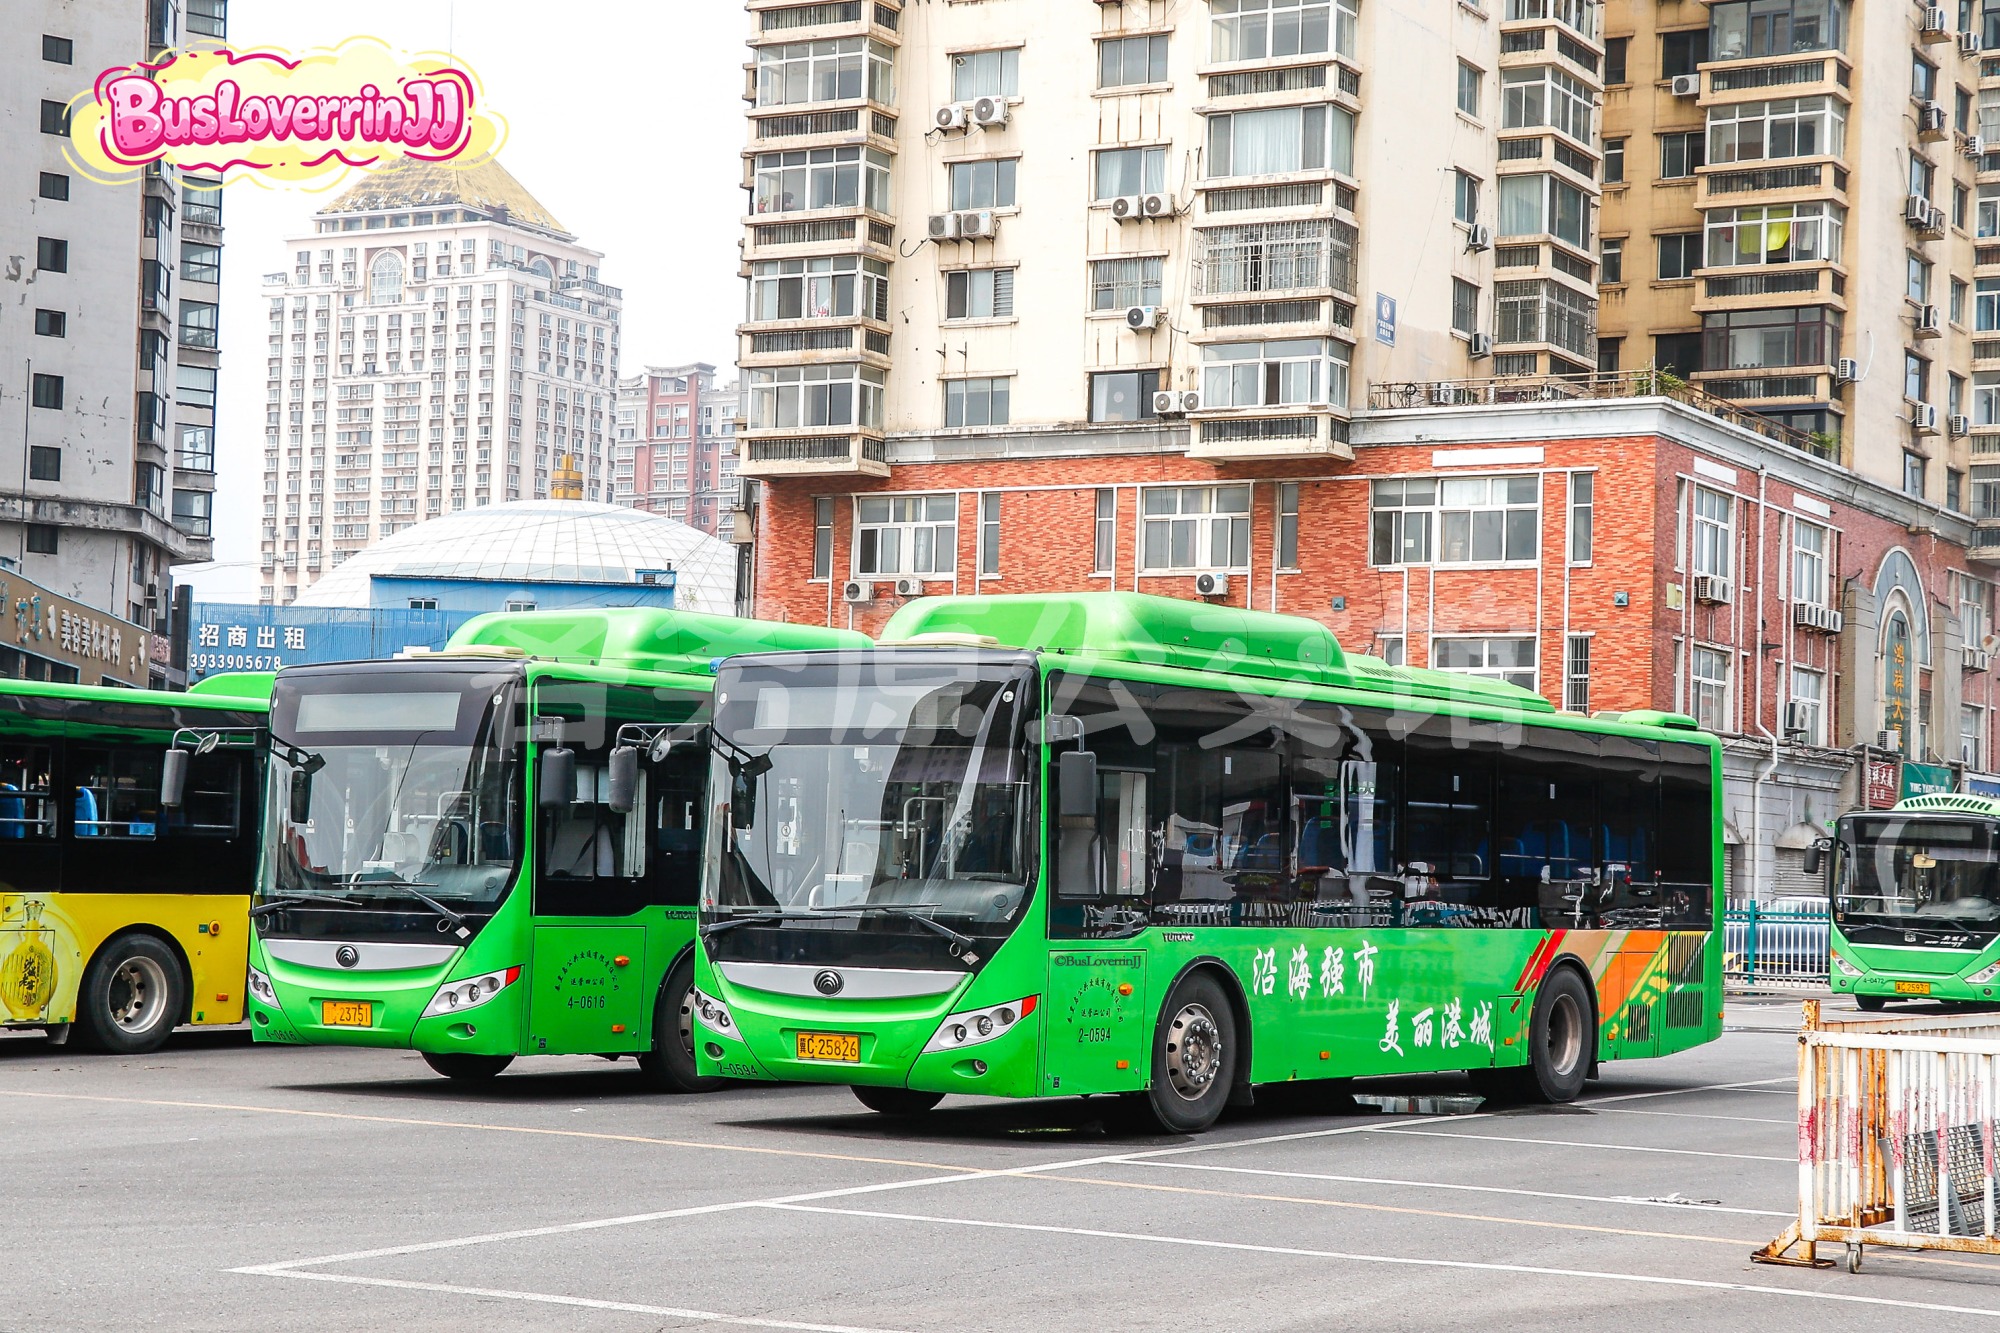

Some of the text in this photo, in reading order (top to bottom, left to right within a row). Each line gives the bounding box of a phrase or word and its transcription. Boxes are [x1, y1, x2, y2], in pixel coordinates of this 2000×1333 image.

[60, 609, 121, 666] 美容美体机构
[198, 623, 306, 650] 招商出租
[190, 653, 281, 670] 3933905678
[1162, 932, 1195, 942] YUTONG
[1253, 939, 1379, 1002] 沿海强市
[567, 995, 606, 1009] 4-0616
[1078, 1028, 1111, 1043] 2-0594
[1379, 997, 1494, 1057] 美丽港城
[716, 1062, 758, 1076] 2-0594
